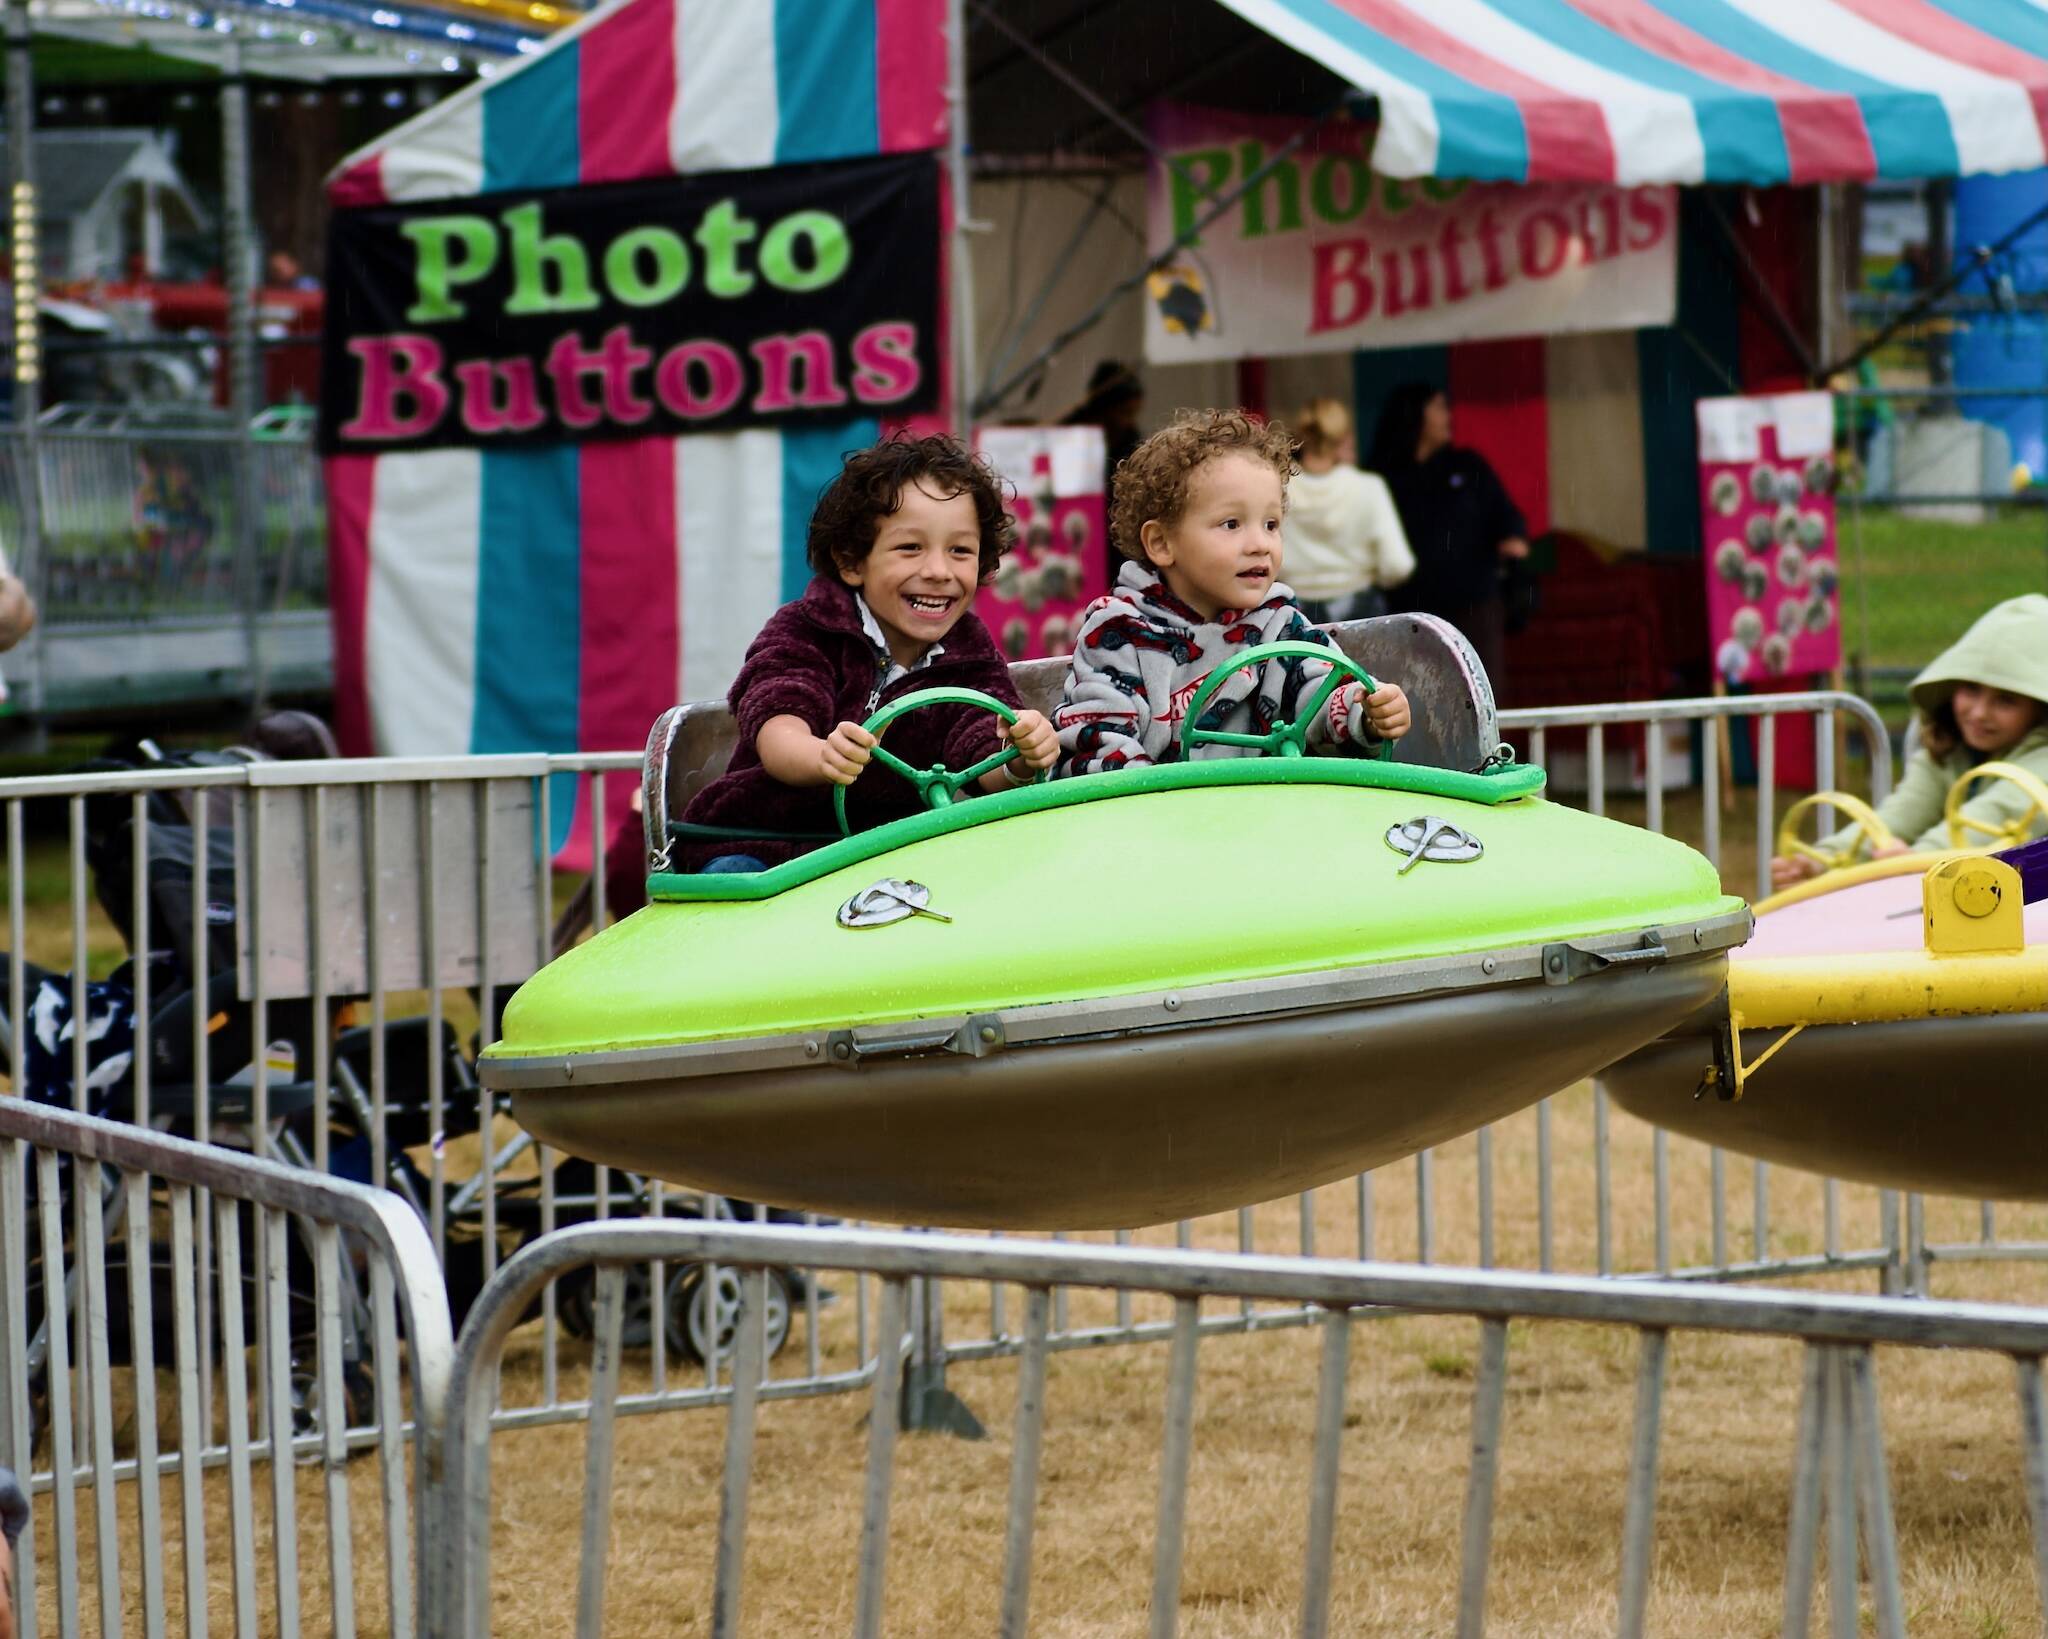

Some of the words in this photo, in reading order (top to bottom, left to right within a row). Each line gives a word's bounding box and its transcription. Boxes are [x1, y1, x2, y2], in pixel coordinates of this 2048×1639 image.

[1169, 140, 1468, 247] Pho
[404, 200, 850, 321] Photo
[1310, 185, 1668, 333] Buttons
[343, 322, 920, 439] Buttons
